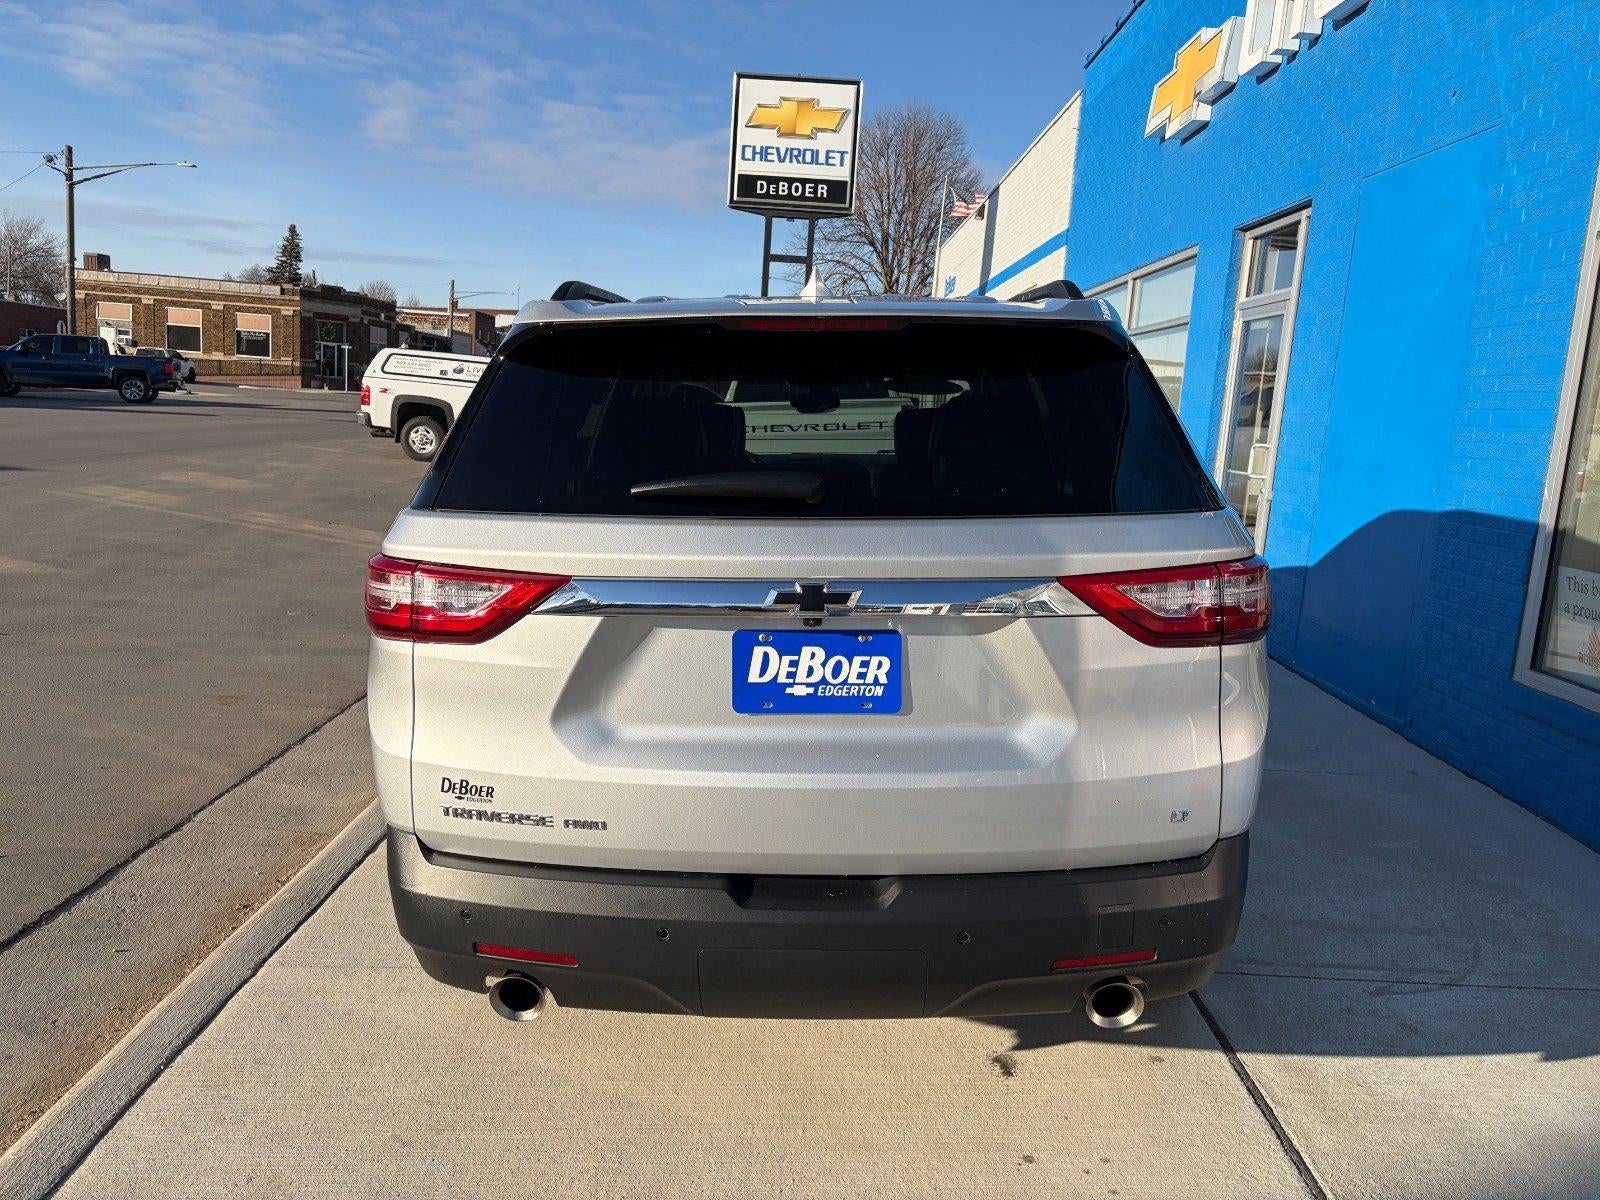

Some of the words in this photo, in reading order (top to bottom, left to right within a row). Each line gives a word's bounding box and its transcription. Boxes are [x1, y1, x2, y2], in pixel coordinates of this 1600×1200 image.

[741, 145, 849, 167] CHEVROLET
[1566, 575, 1589, 595] This
[817, 685, 884, 697] EDGERTON
[439, 804, 555, 828] TRAVERSE
[563, 818, 608, 831] AWD
